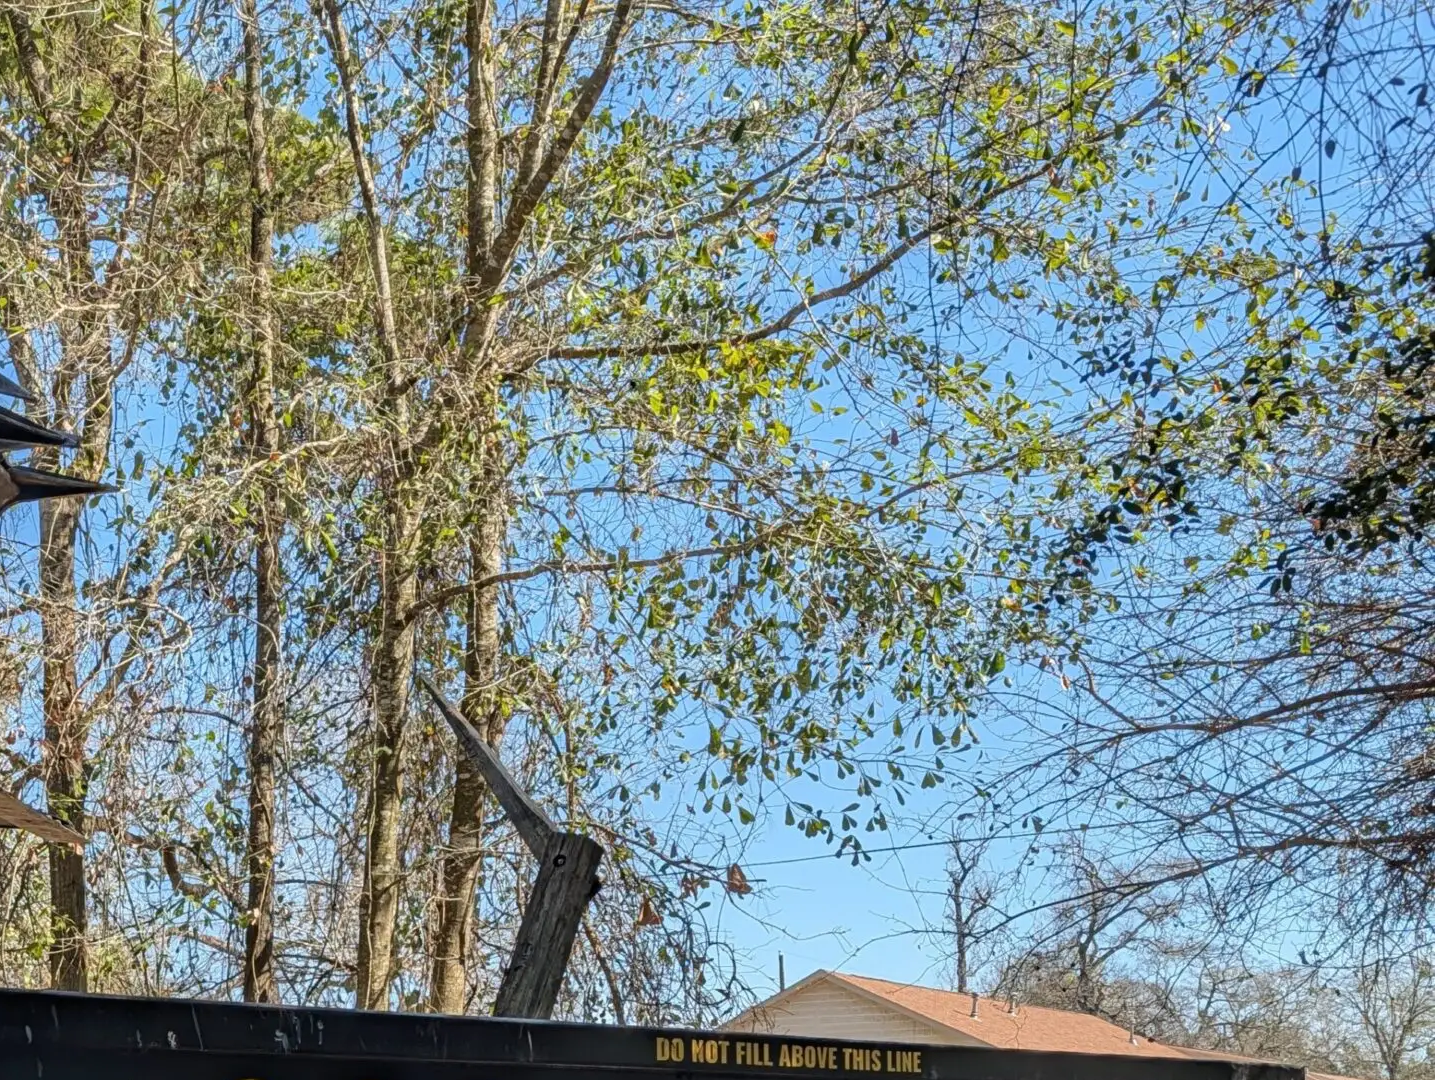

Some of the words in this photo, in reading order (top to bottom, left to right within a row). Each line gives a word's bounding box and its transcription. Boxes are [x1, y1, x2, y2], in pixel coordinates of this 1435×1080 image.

[655, 1036, 685, 1063] DO
[691, 1038, 730, 1065] NOT
[735, 1041, 774, 1067] FILL
[778, 1043, 838, 1071] ABOVE
[842, 1047, 882, 1073] THIS
[886, 1050, 922, 1074] LINE
